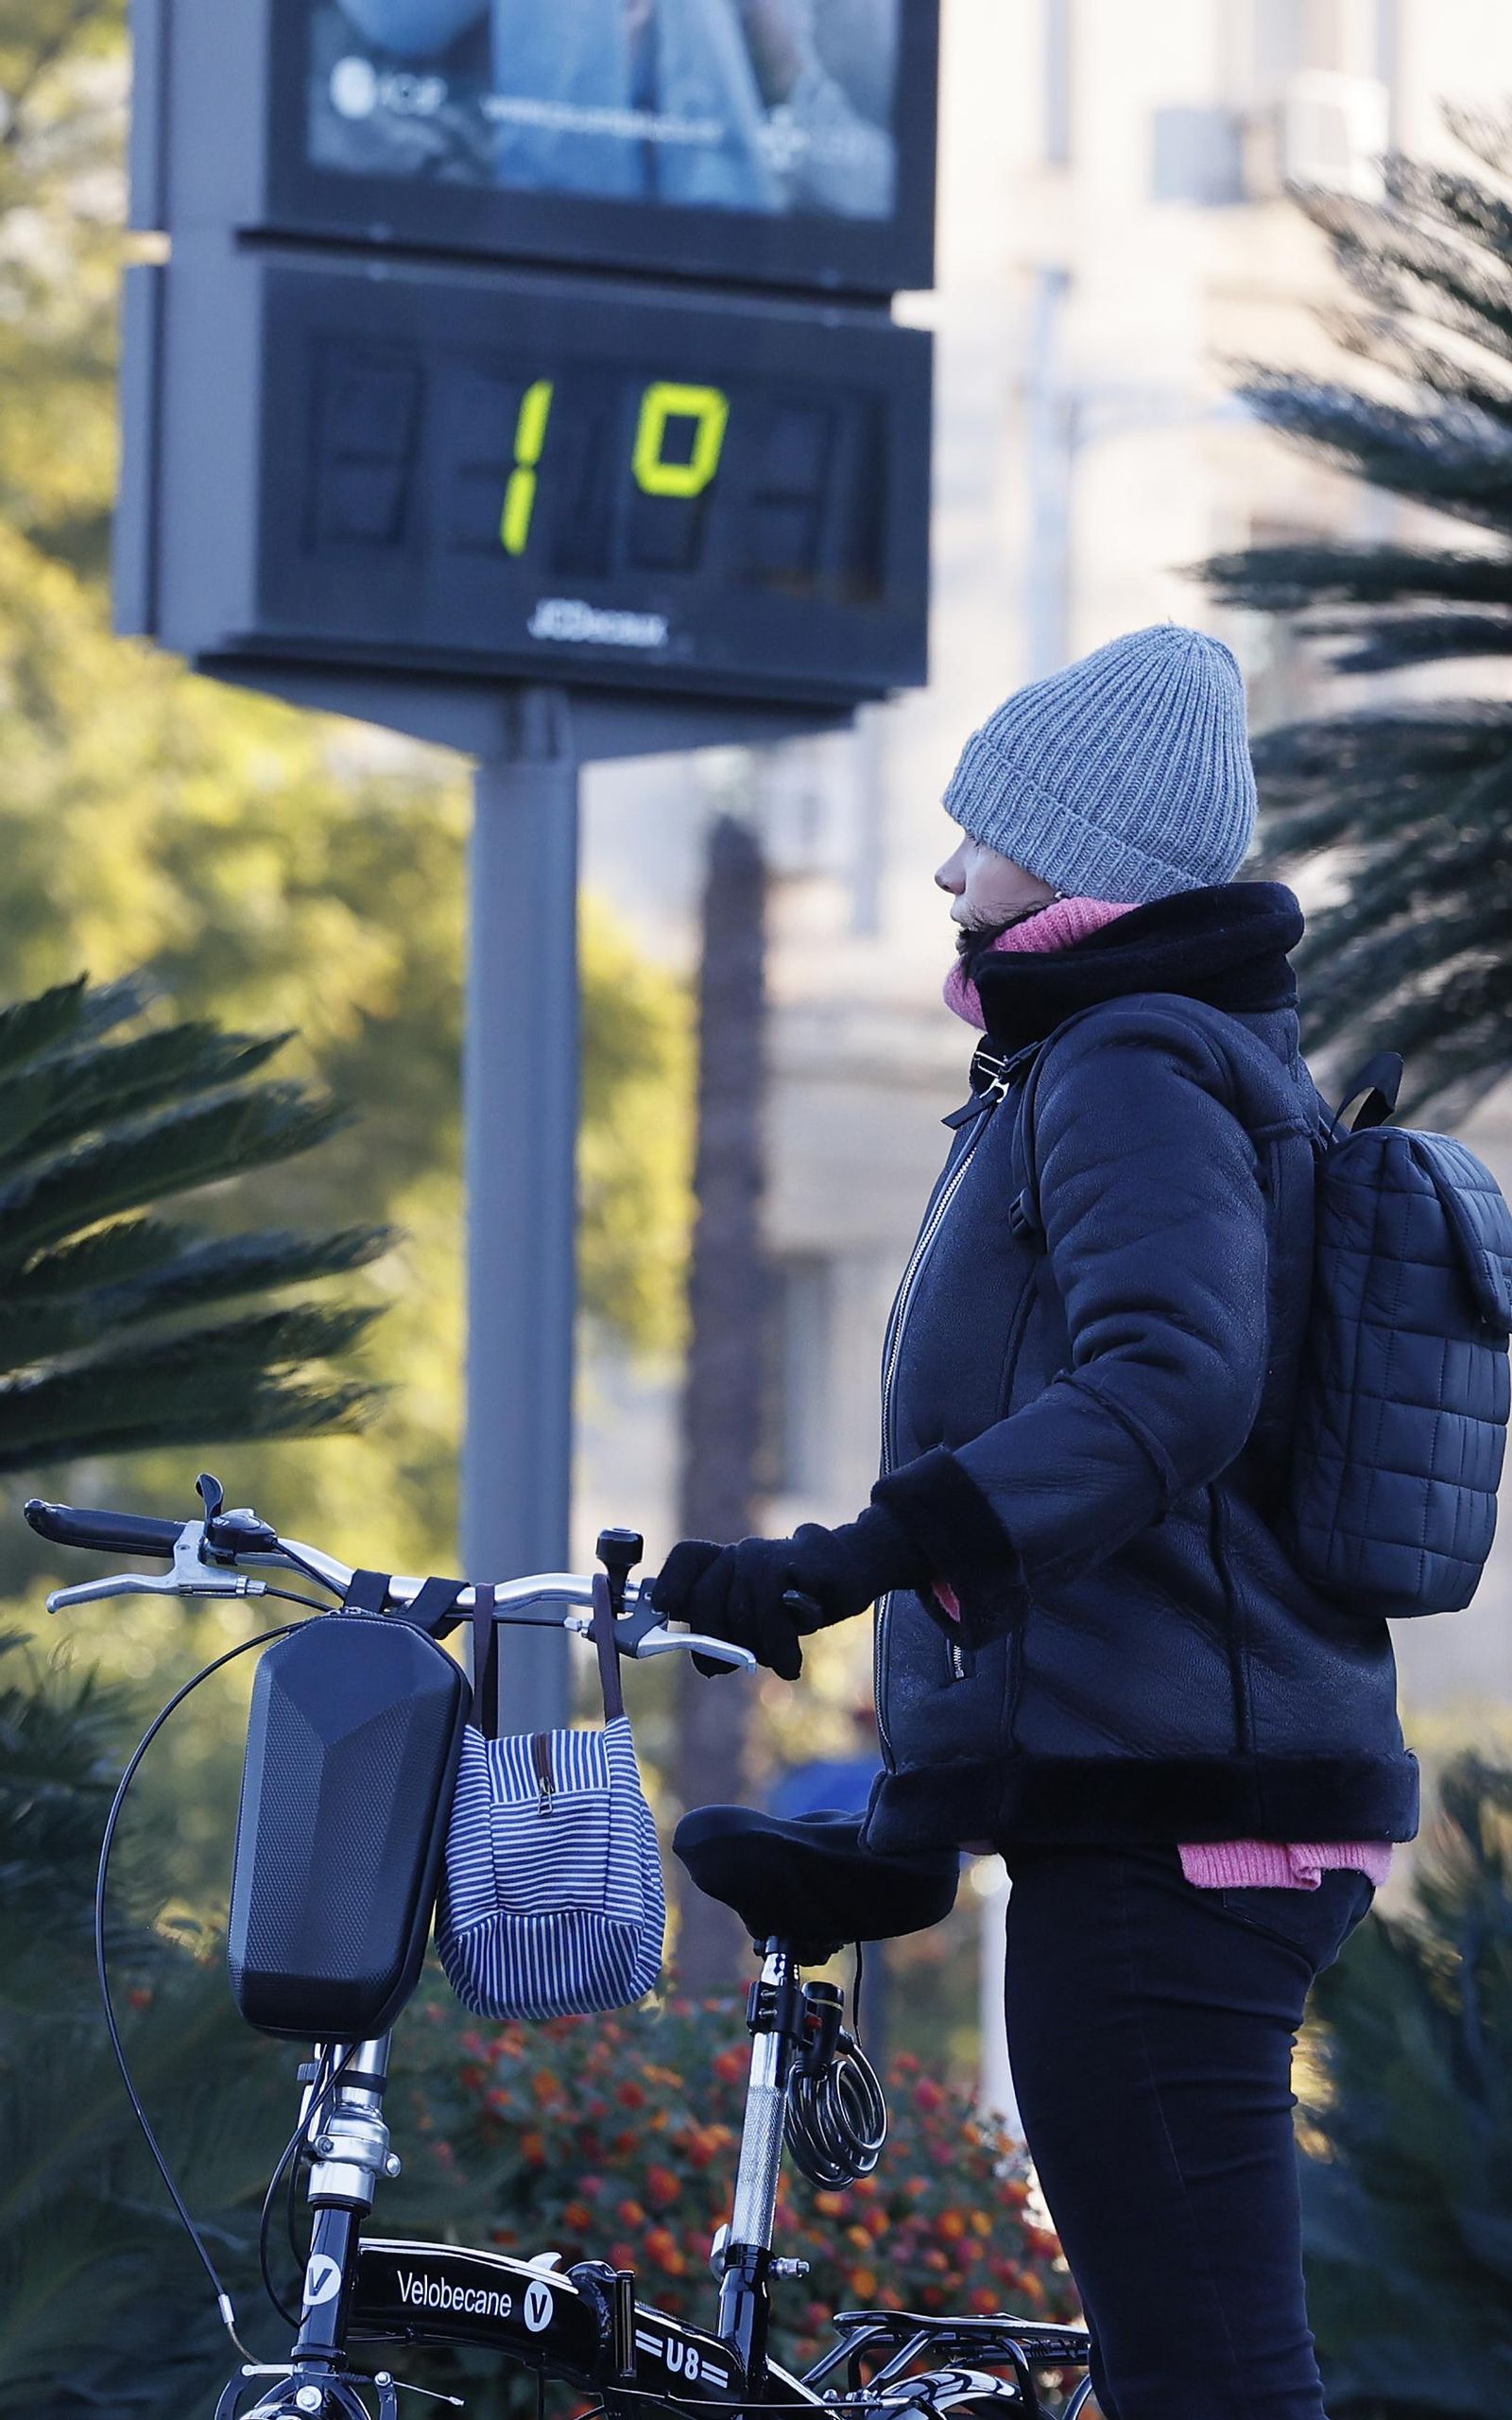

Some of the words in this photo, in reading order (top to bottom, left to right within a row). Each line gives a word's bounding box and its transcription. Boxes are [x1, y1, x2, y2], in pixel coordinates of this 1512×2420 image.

[307, 2266, 335, 2298] V
[397, 2270, 512, 2317] Velobecane
[528, 2290, 549, 2325] V
